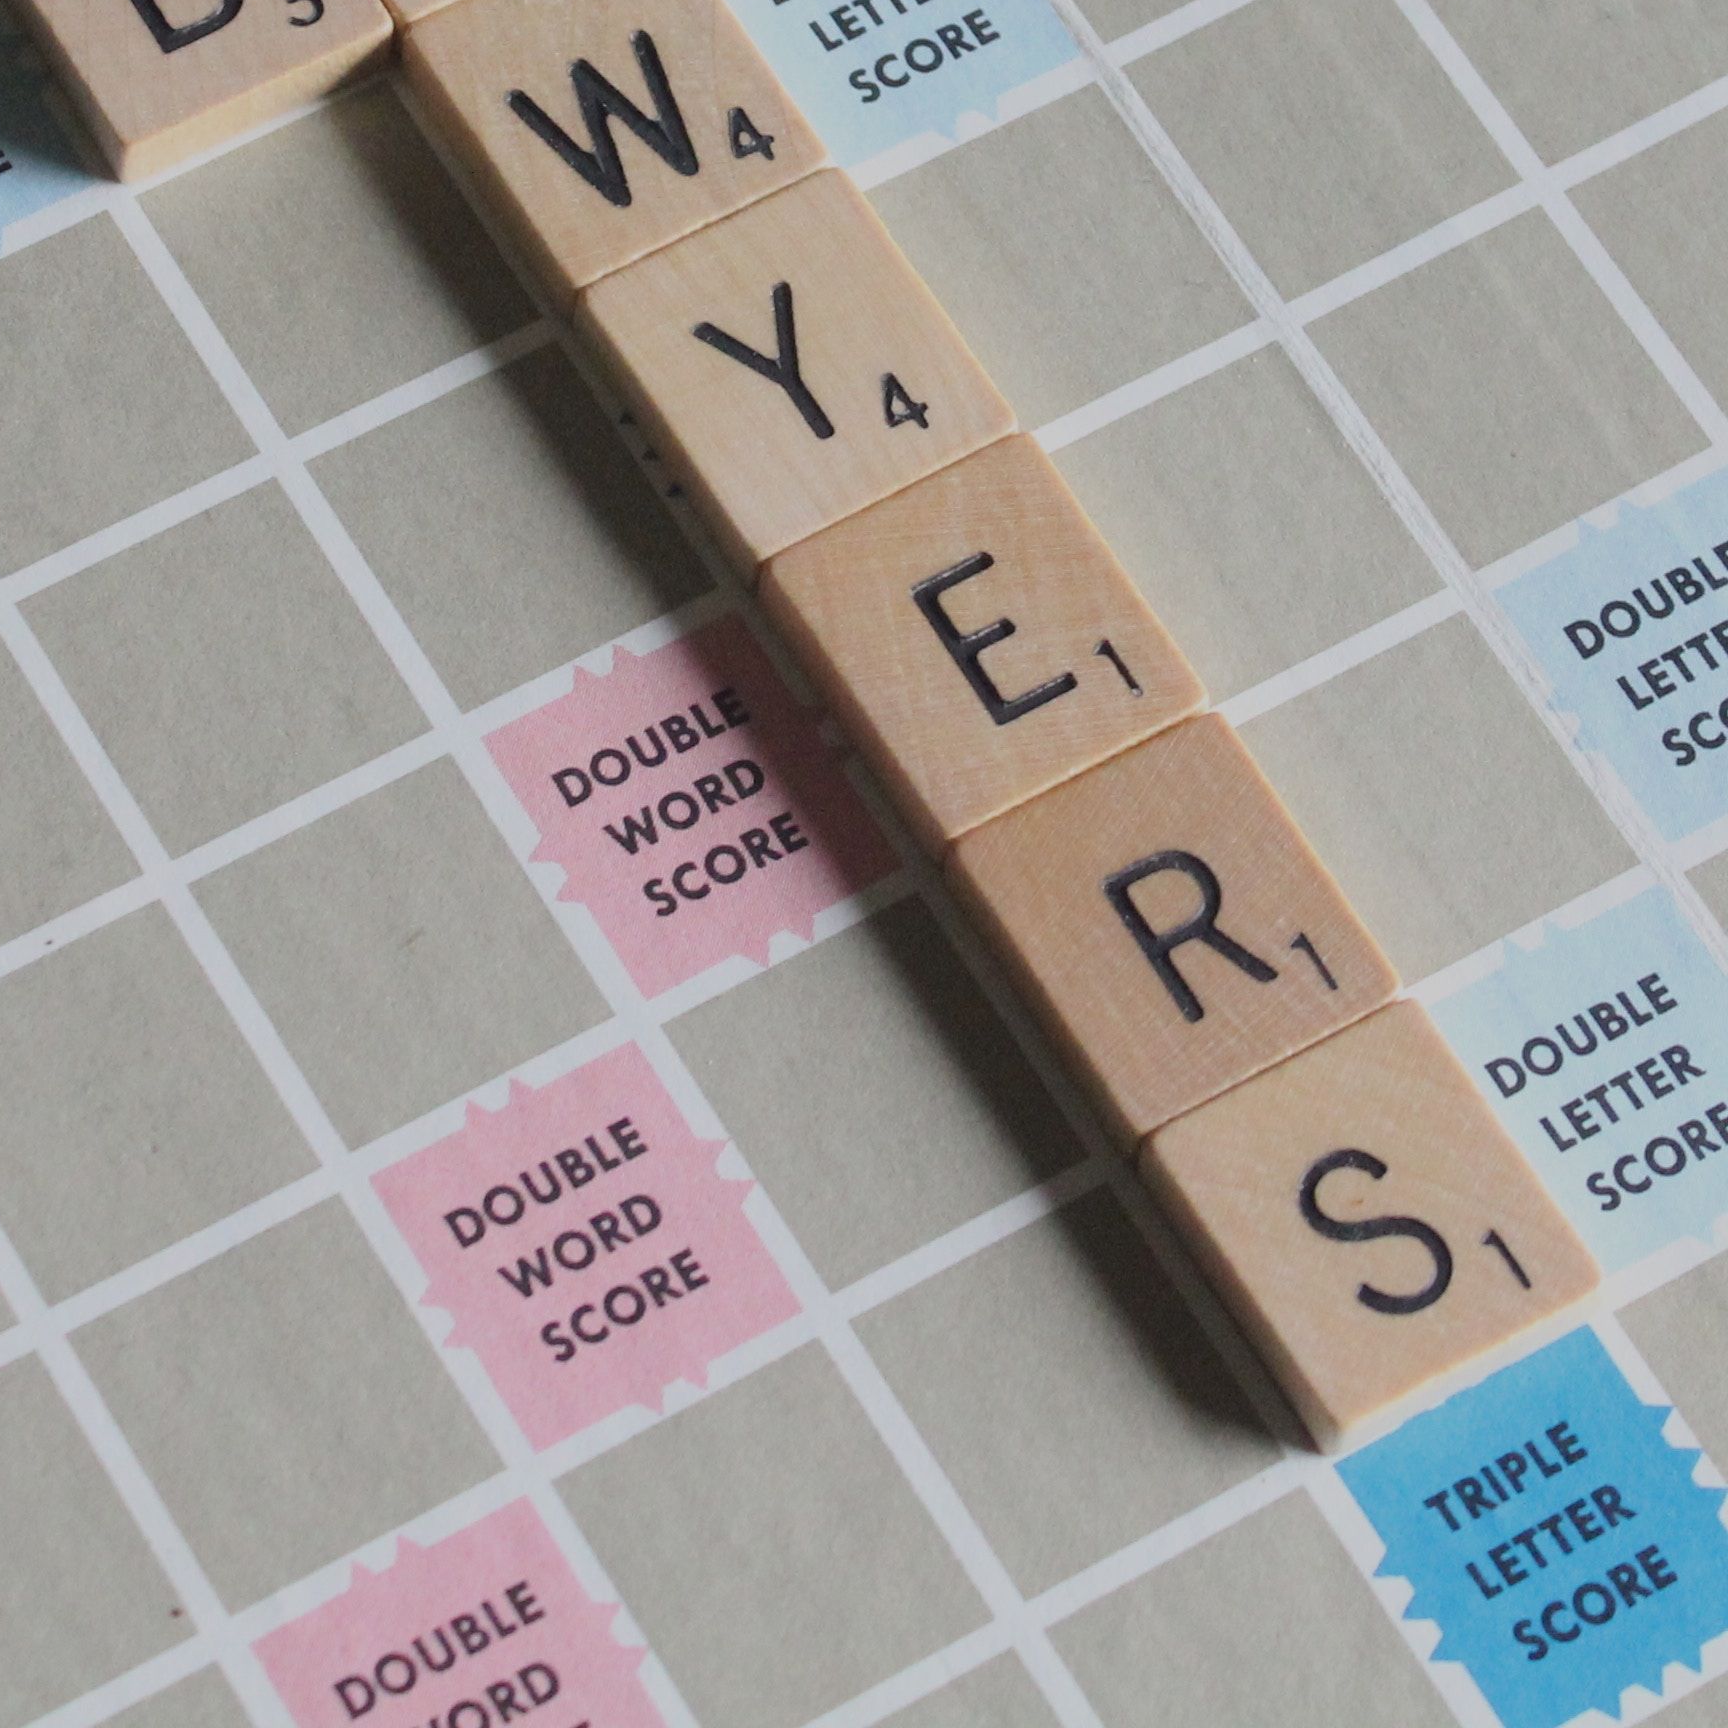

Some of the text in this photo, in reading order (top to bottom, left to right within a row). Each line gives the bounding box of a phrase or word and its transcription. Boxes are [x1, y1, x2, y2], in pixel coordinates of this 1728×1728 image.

[847, 7, 1002, 105] SCORE
[550, 686, 752, 810] DOUBLE
[601, 758, 766, 857] WORD
[641, 810, 811, 919] SCORE
[1483, 971, 1680, 1100] DOUBLE
[1538, 1043, 1708, 1154] LETTER
[442, 1116, 649, 1250] DOUBLE
[495, 1193, 664, 1300] WORD
[539, 1247, 711, 1364] SCORE
[1422, 1419, 1590, 1533] TRIPLE
[1464, 1484, 1638, 1601] LETTER
[331, 1579, 546, 1722] DOUBLE
[1511, 1543, 1680, 1663] SCORE
[426, 1660, 561, 1728] ORD
